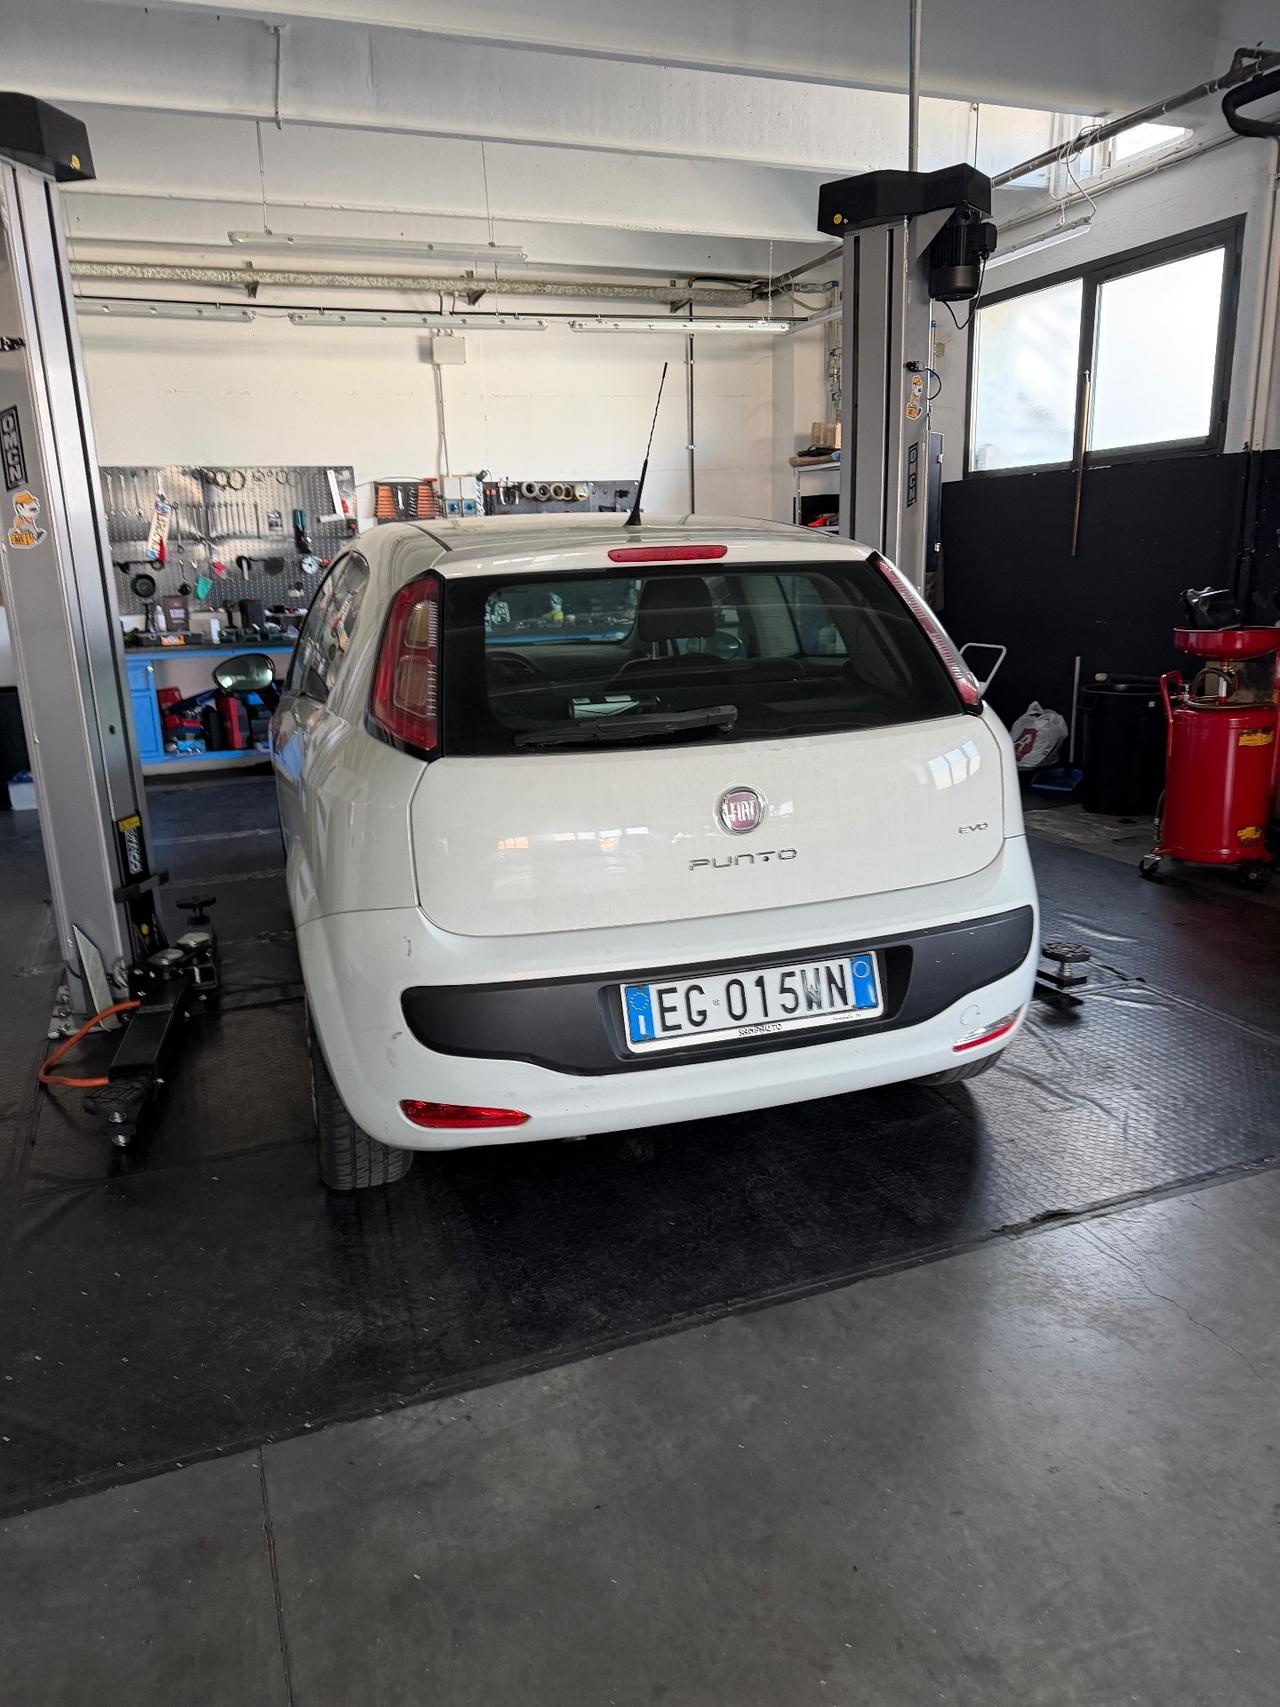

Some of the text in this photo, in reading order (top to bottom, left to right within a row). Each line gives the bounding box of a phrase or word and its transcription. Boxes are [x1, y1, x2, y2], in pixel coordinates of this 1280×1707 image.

[727, 800, 757, 821] FIAT
[958, 822, 988, 834] EVO
[689, 848, 797, 871] PUNTO
[656, 984, 708, 1032] EG
[726, 964, 849, 1021] 015WN
